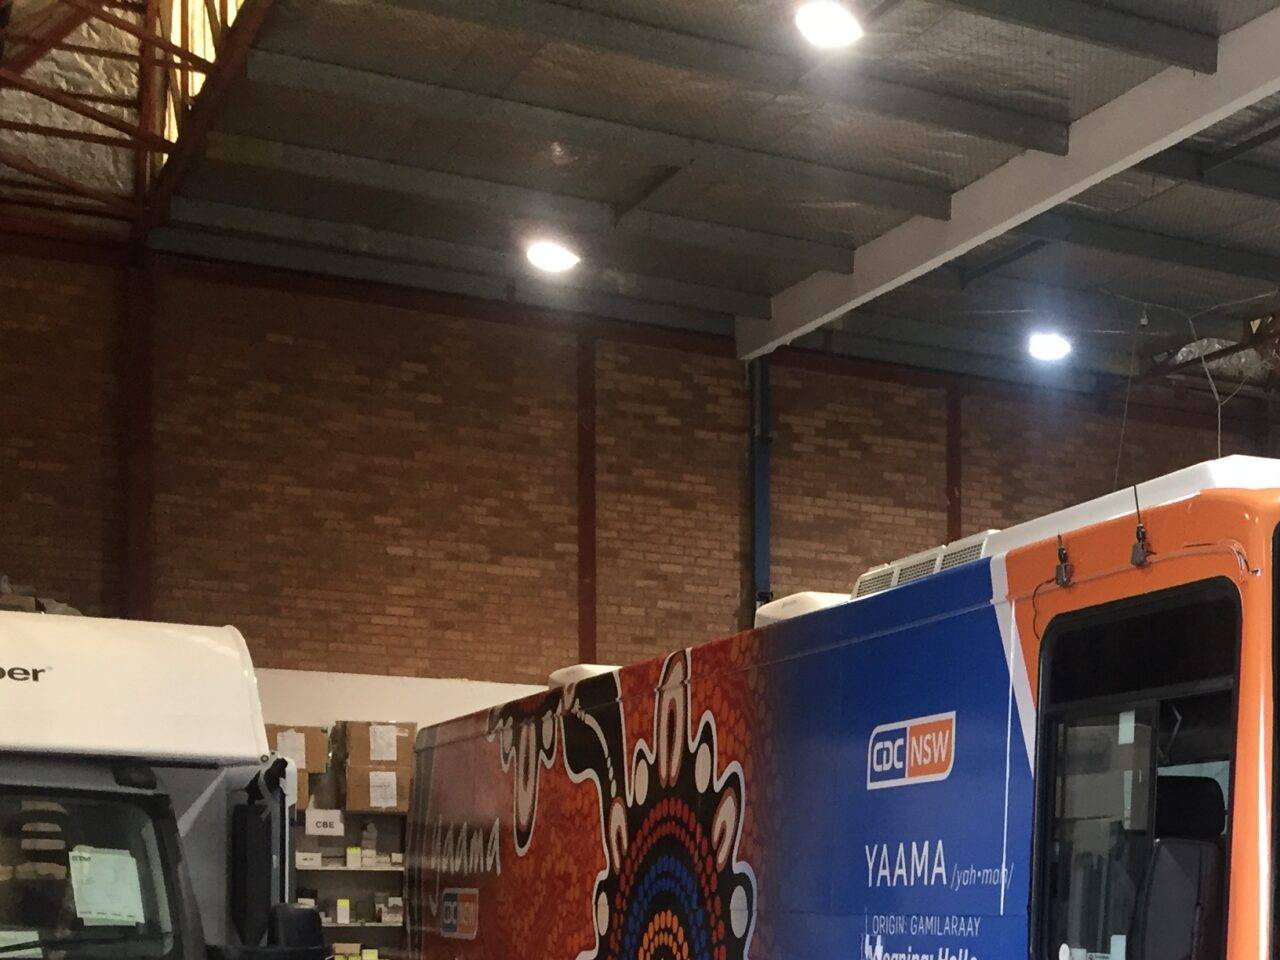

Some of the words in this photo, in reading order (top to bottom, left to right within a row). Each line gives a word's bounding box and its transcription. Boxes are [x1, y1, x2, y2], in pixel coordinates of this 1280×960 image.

[872, 738, 905, 773] CDC
[910, 729, 949, 768] NSW
[865, 839, 947, 888] YAAMA
[872, 914, 907, 936] ORIGIN:
[910, 915, 981, 937] GAMILARAAY
